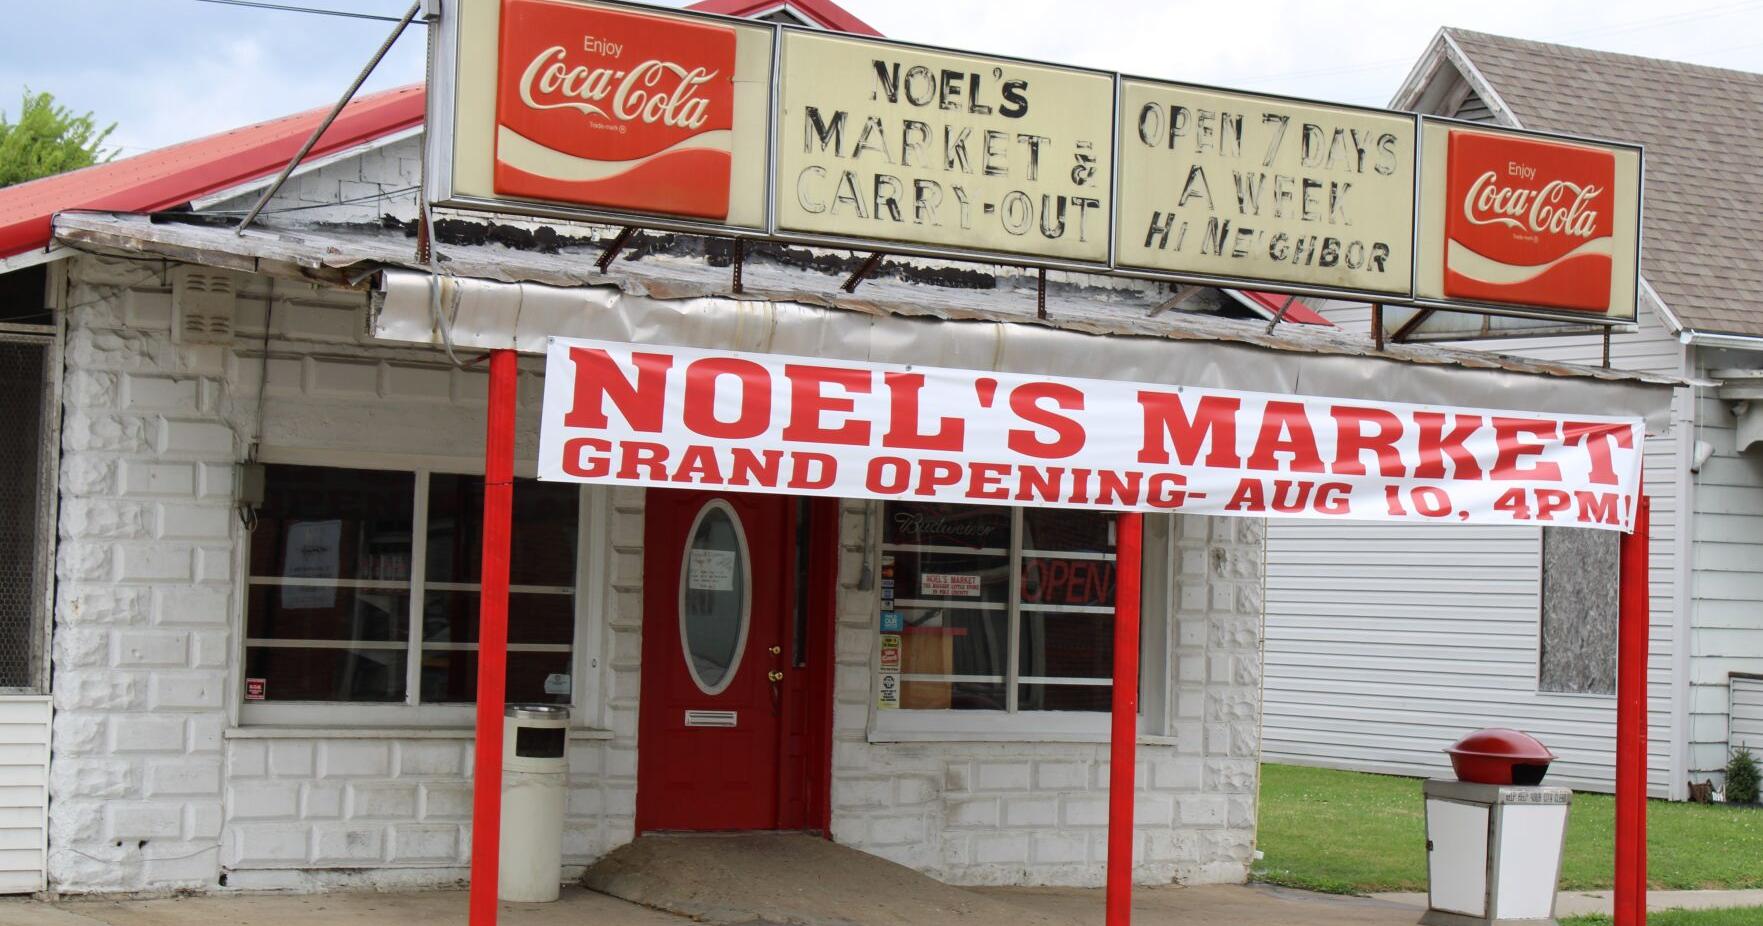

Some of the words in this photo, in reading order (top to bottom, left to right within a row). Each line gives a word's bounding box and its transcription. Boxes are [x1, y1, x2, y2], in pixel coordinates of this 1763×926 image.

[583, 35, 624, 59] Enjoy
[519, 45, 720, 130] Coca-Cola
[871, 59, 1030, 118] NOEL'S
[804, 105, 1052, 181] MARKET
[1138, 101, 1244, 157] OPEN
[1262, 112, 1291, 167] 7
[1301, 122, 1398, 176] DAYS
[1508, 161, 1537, 181] Enjoy
[796, 165, 1101, 242] CARRY-OUT
[1178, 164, 1214, 211] A
[1463, 170, 1604, 238] Coca-Cola
[564, 346, 1087, 460] NOEL'S
[1136, 390, 1634, 486] MARKET
[561, 437, 838, 491] GRAND
[1224, 477, 1353, 514] AUG
[1493, 487, 1632, 529] 4PM!
[1021, 558, 1111, 603] OPEN
